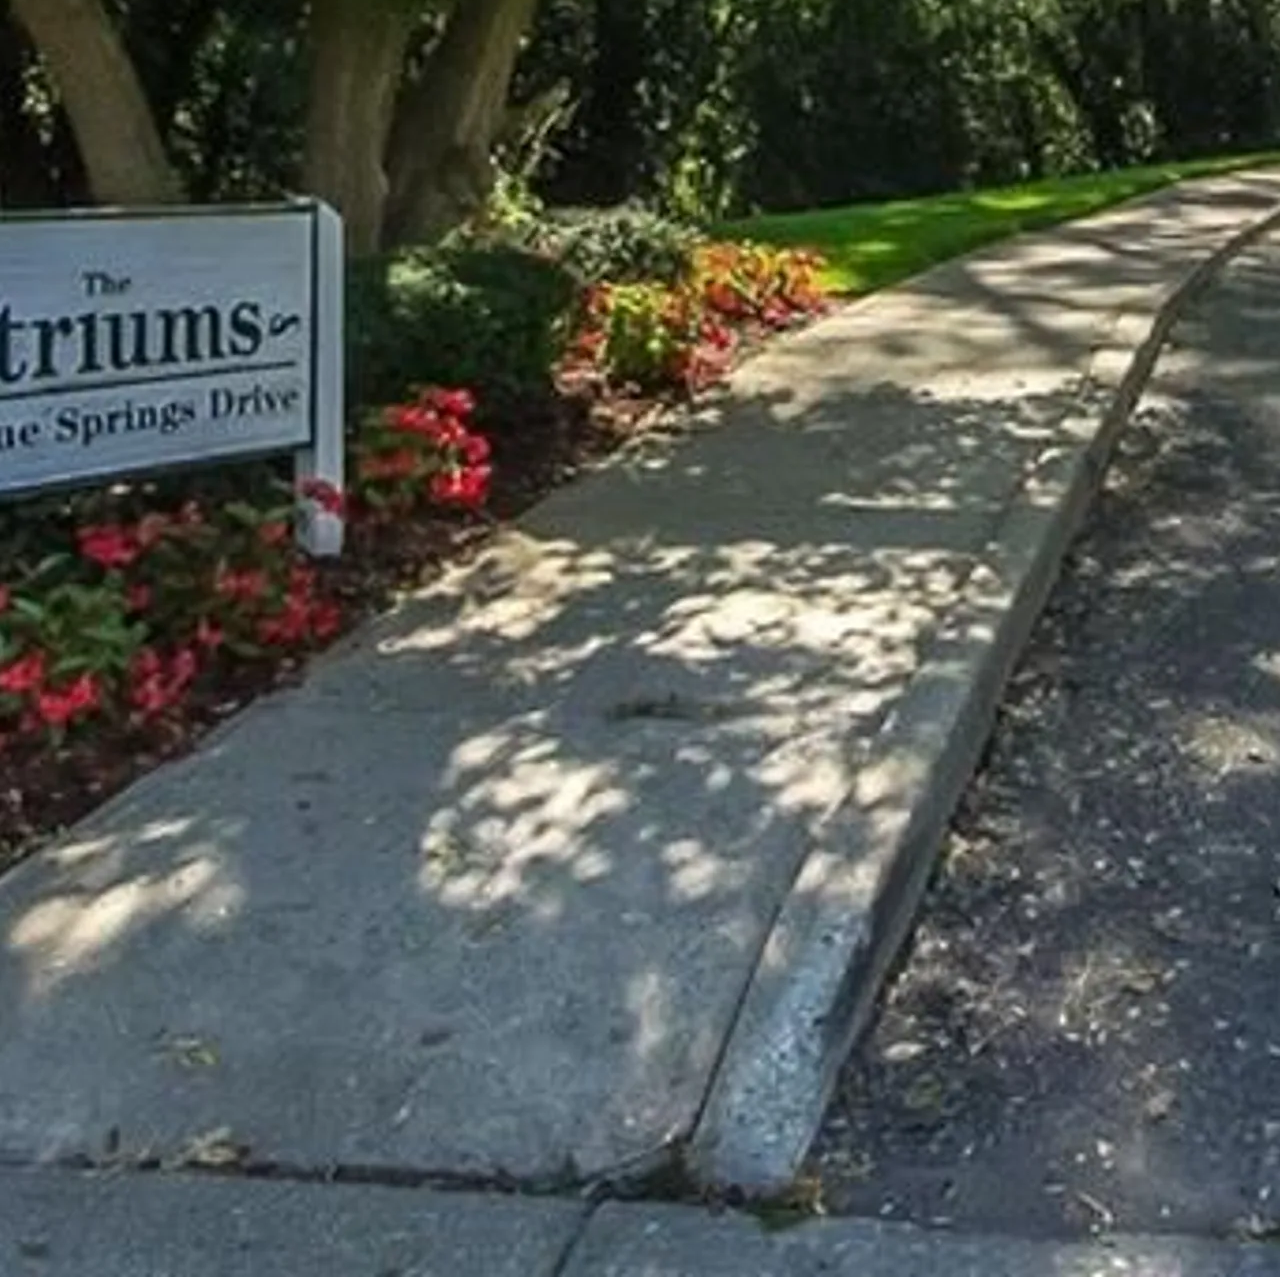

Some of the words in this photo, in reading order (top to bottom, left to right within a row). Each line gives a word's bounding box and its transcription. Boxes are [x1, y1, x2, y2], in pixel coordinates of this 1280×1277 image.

[81, 271, 131, 297] The
[55, 401, 196, 446] Springs
[210, 385, 300, 419] Drive
